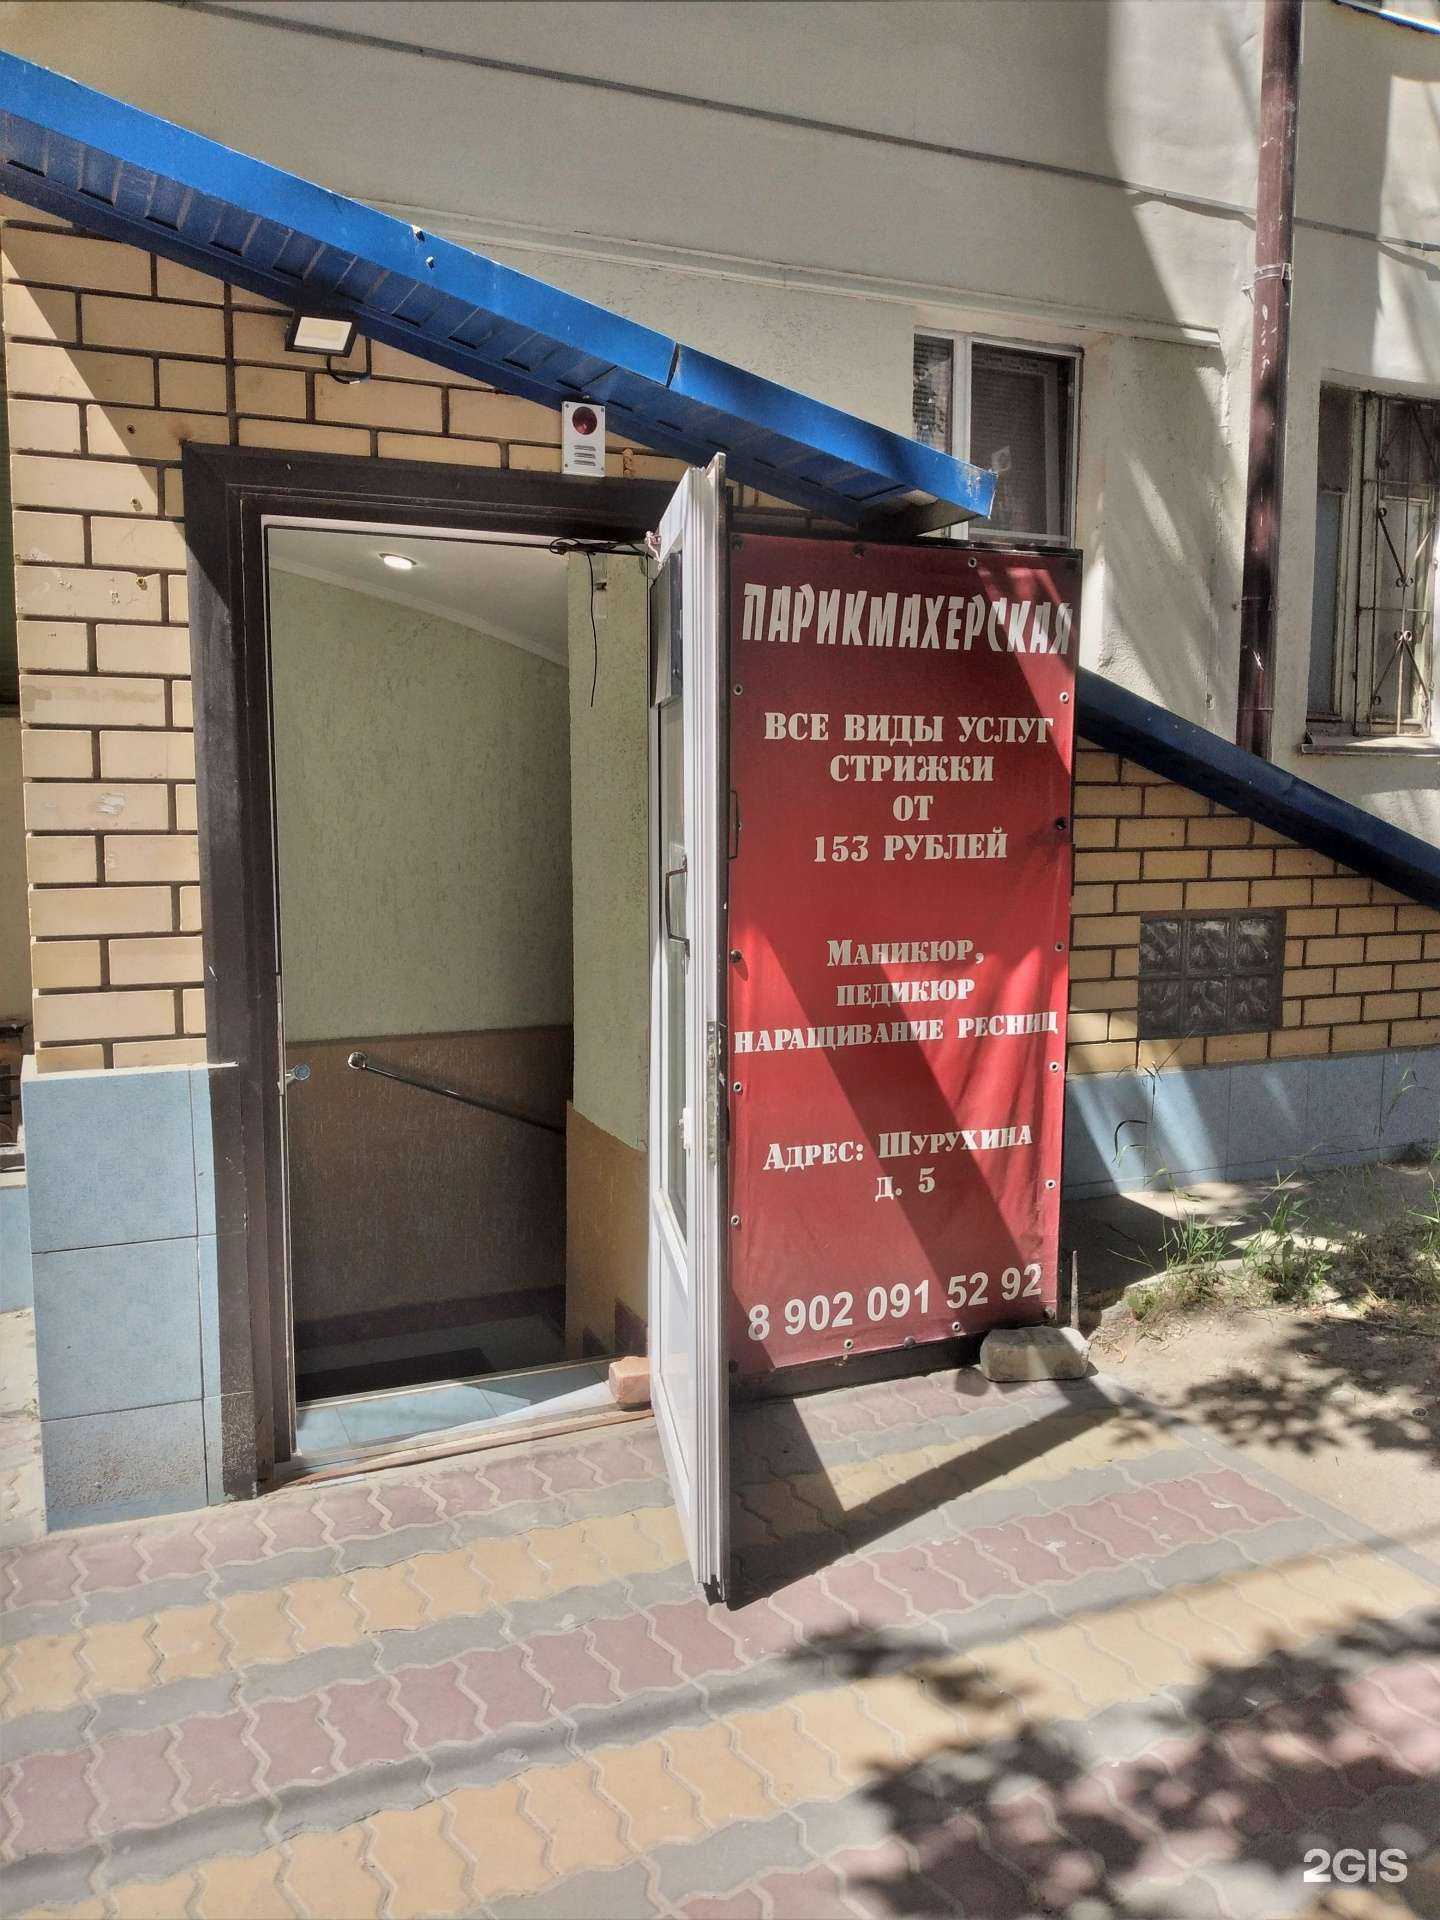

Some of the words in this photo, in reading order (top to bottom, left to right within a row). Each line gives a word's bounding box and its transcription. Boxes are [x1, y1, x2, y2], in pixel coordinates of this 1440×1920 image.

[742, 583, 1073, 655] ПАРИКМАХЕРСКАЯ
[764, 712, 829, 740] ВСЕ
[844, 714, 943, 747] ВИДЫ
[958, 716, 1054, 743] УСЛУГ
[830, 755, 994, 782] СТРИЖКИ
[892, 795, 933, 821] ОТ
[814, 836, 869, 863] 153
[883, 827, 1008, 861] РУБЛЕЙ
[918, 1167, 936, 1193] 5
[748, 1303, 770, 1341] 8
[784, 1291, 854, 1335] 902
[867, 1279, 930, 1322] 091
[947, 1271, 989, 1309] 52
[1001, 1262, 1043, 1300] 92
